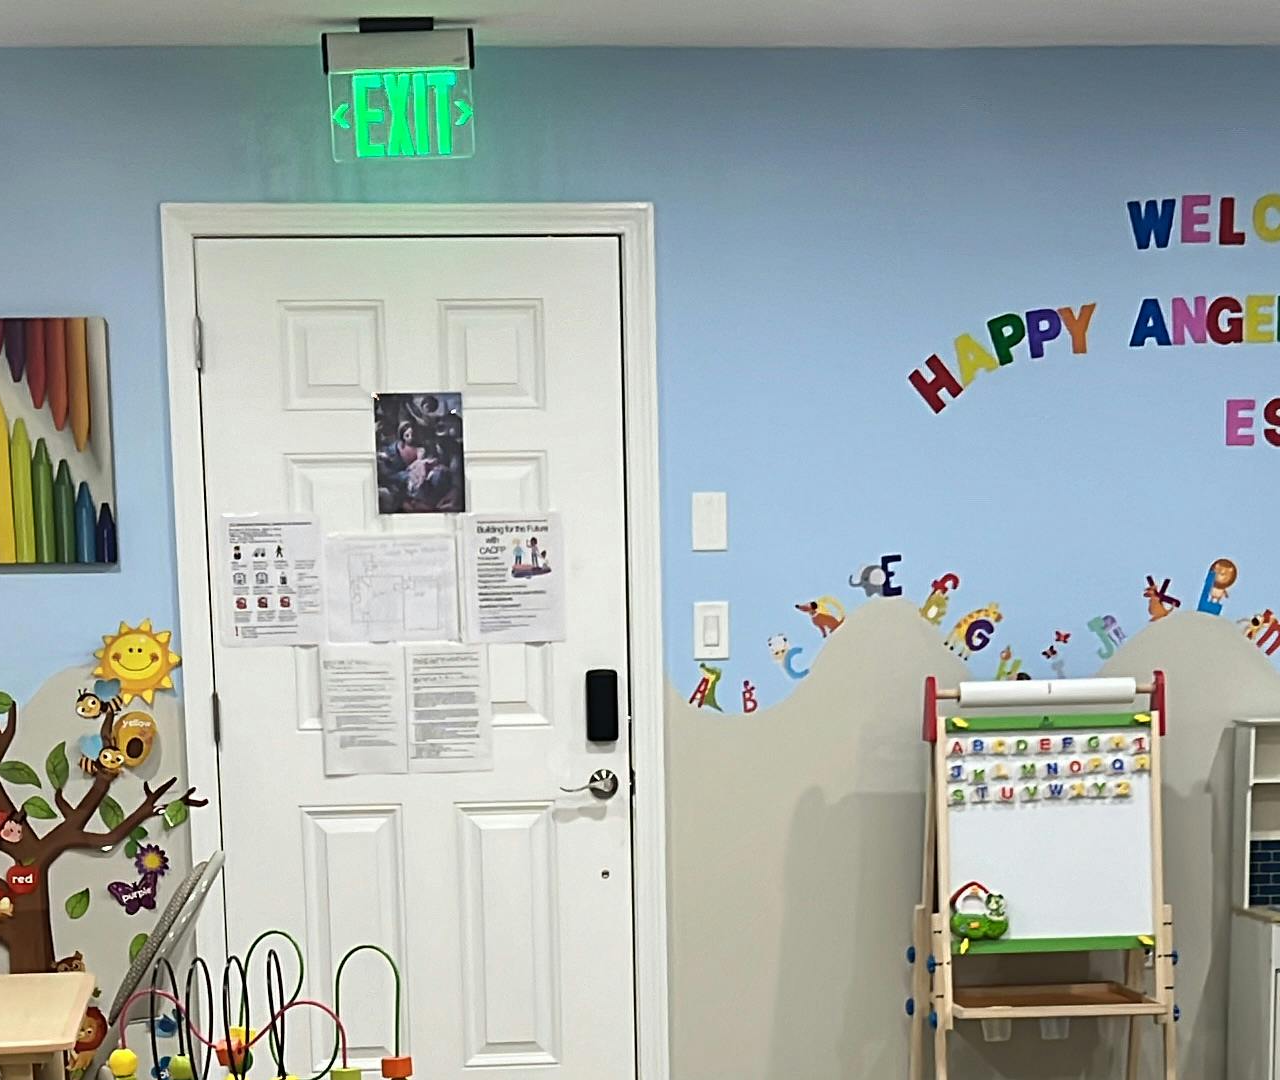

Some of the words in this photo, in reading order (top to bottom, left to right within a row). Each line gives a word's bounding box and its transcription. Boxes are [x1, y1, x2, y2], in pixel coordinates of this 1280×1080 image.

[352, 71, 457, 157] EXIT
[909, 302, 1097, 414] HAPPY
[689, 677, 710, 708] A
[742, 690, 758, 713] B
[784, 647, 810, 679] C
[881, 554, 903, 597] E
[965, 619, 995, 651] G
[12, 874, 33, 884] red
[122, 887, 152, 902] purple
